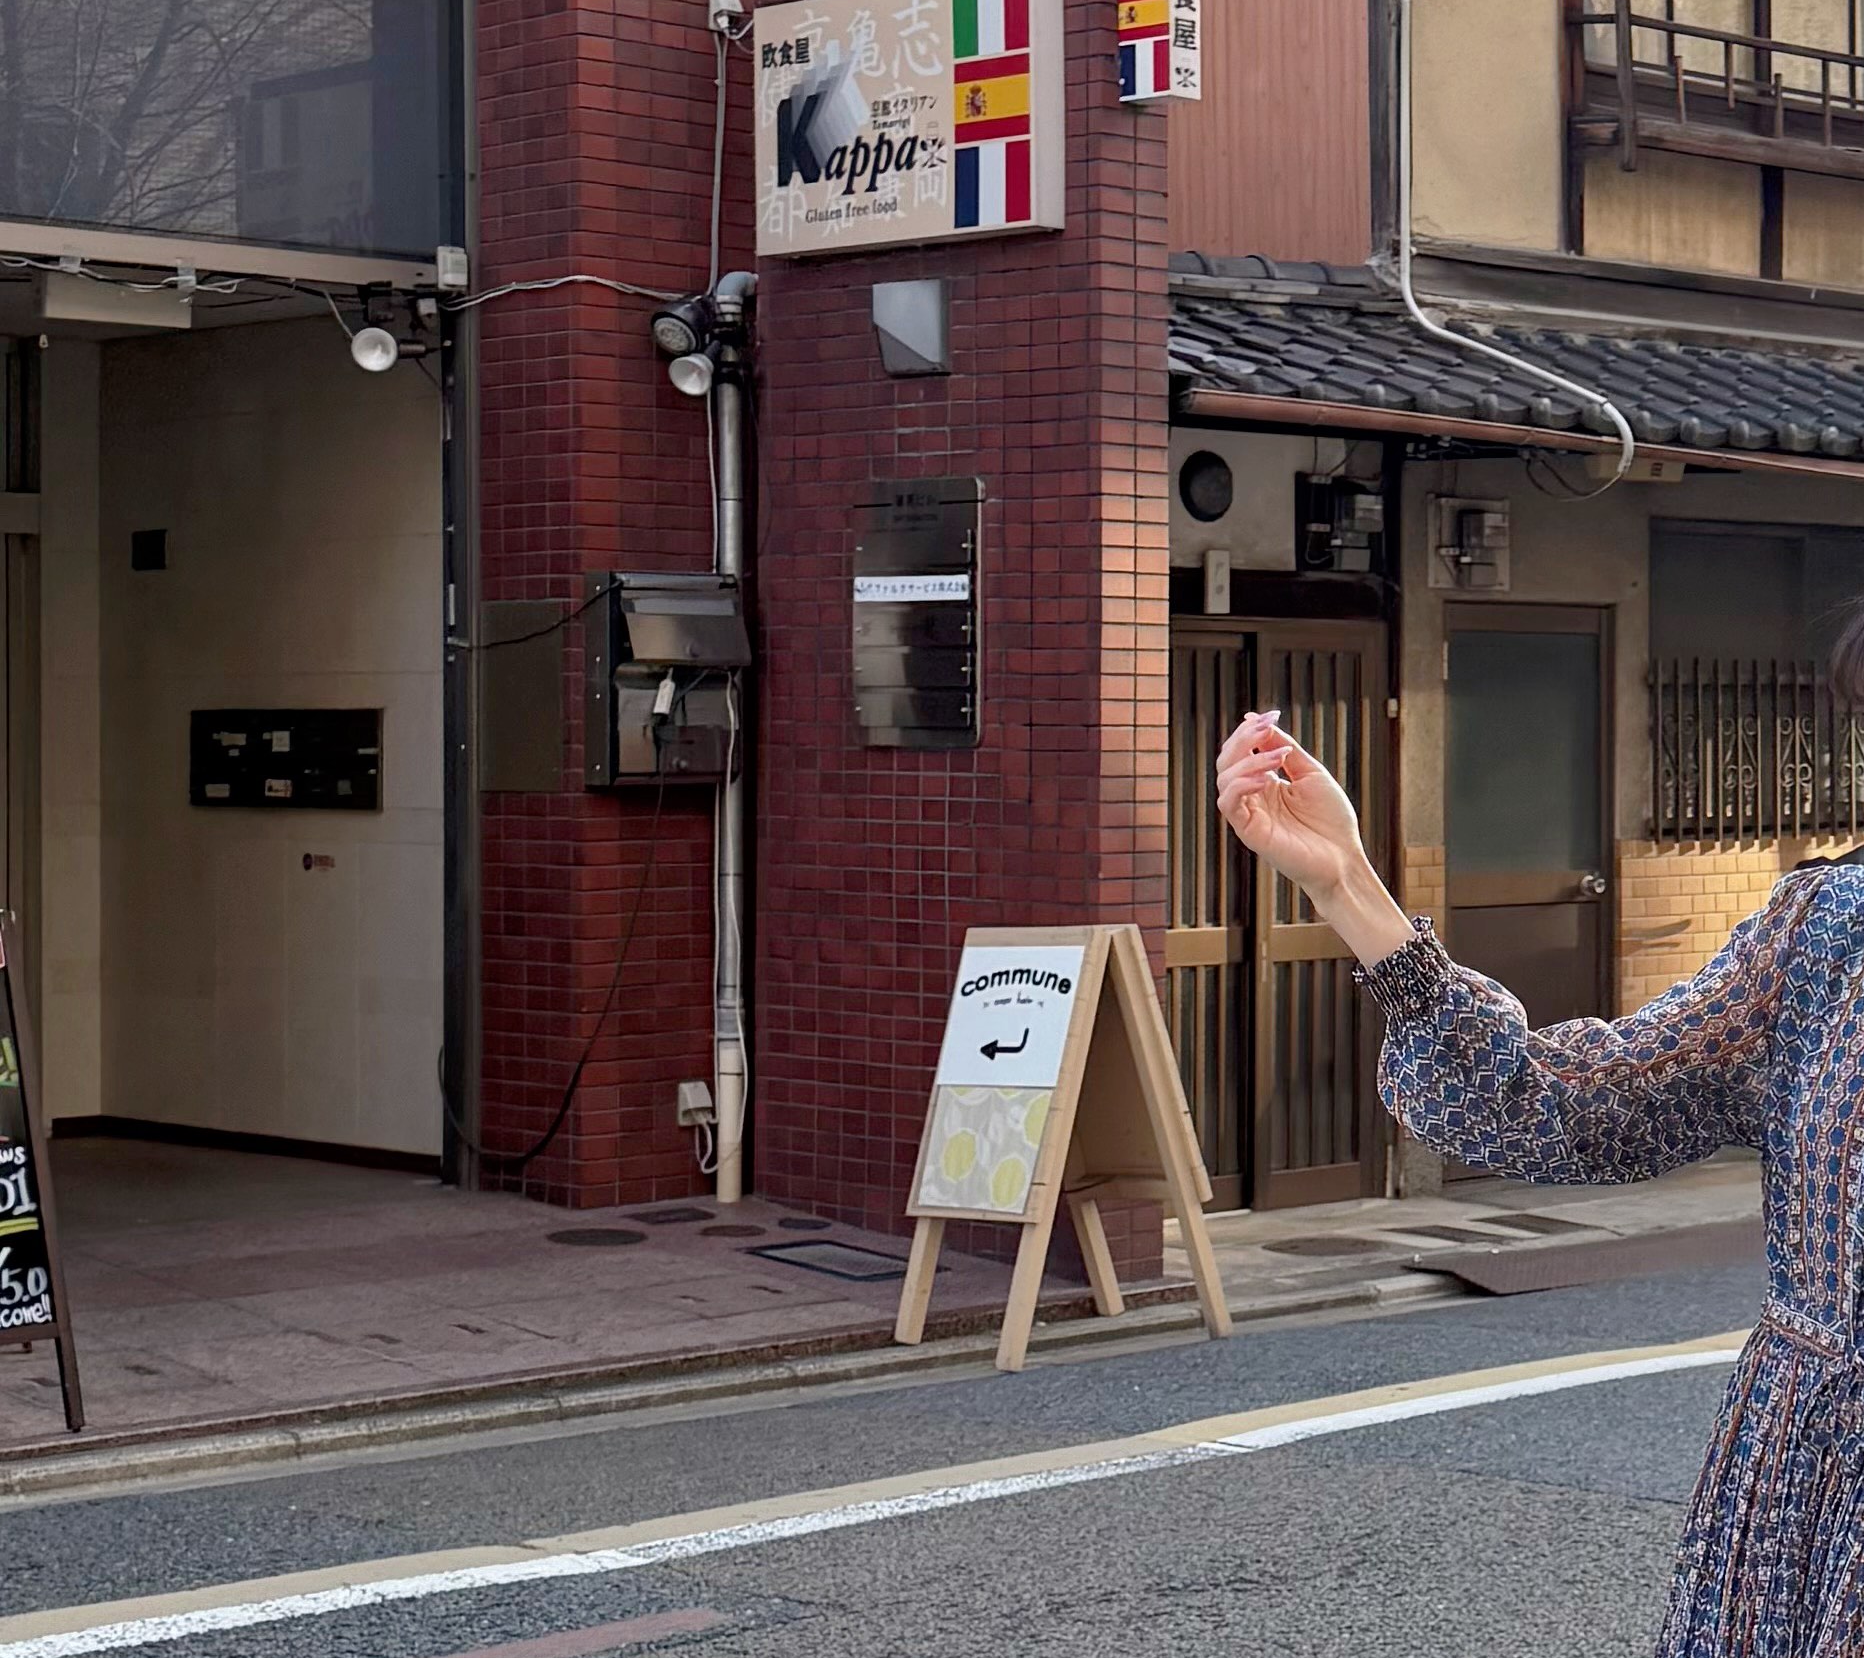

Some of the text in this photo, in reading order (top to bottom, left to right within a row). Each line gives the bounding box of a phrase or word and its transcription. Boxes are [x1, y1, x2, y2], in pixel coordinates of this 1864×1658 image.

[761, 37, 811, 70] 欧食屋
[777, 90, 919, 196] Kappa
[805, 196, 898, 224] Gluten free food
[961, 968, 1072, 997] commune
